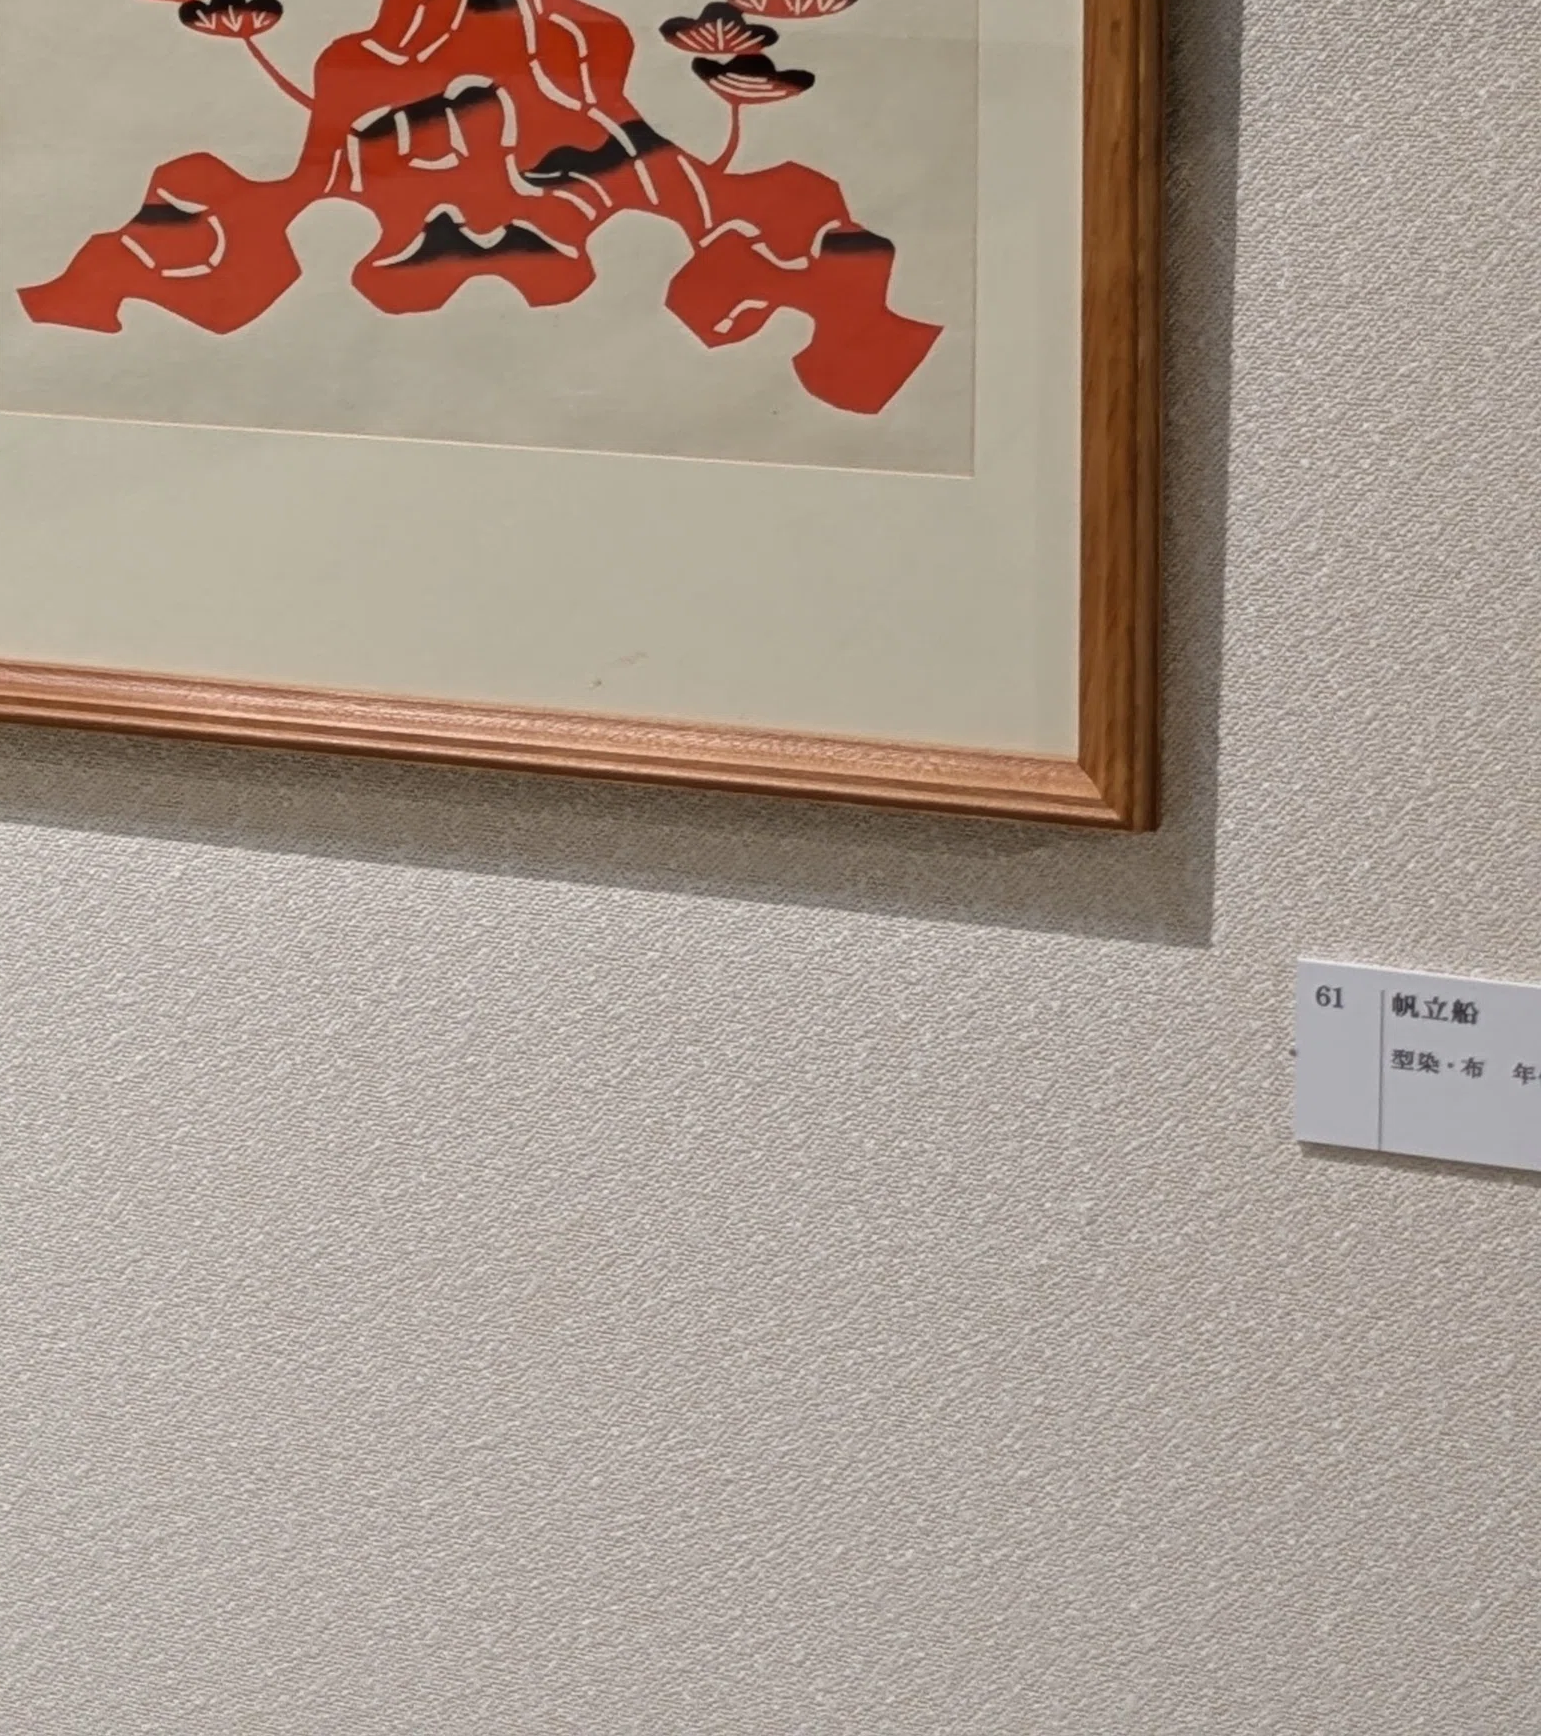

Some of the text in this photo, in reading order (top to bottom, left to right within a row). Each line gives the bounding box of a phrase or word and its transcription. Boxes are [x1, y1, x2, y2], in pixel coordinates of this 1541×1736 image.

[1315, 985, 1344, 1009] 61
[1392, 993, 1480, 1025] 帆立船
[1512, 1062, 1541, 1086] 年
